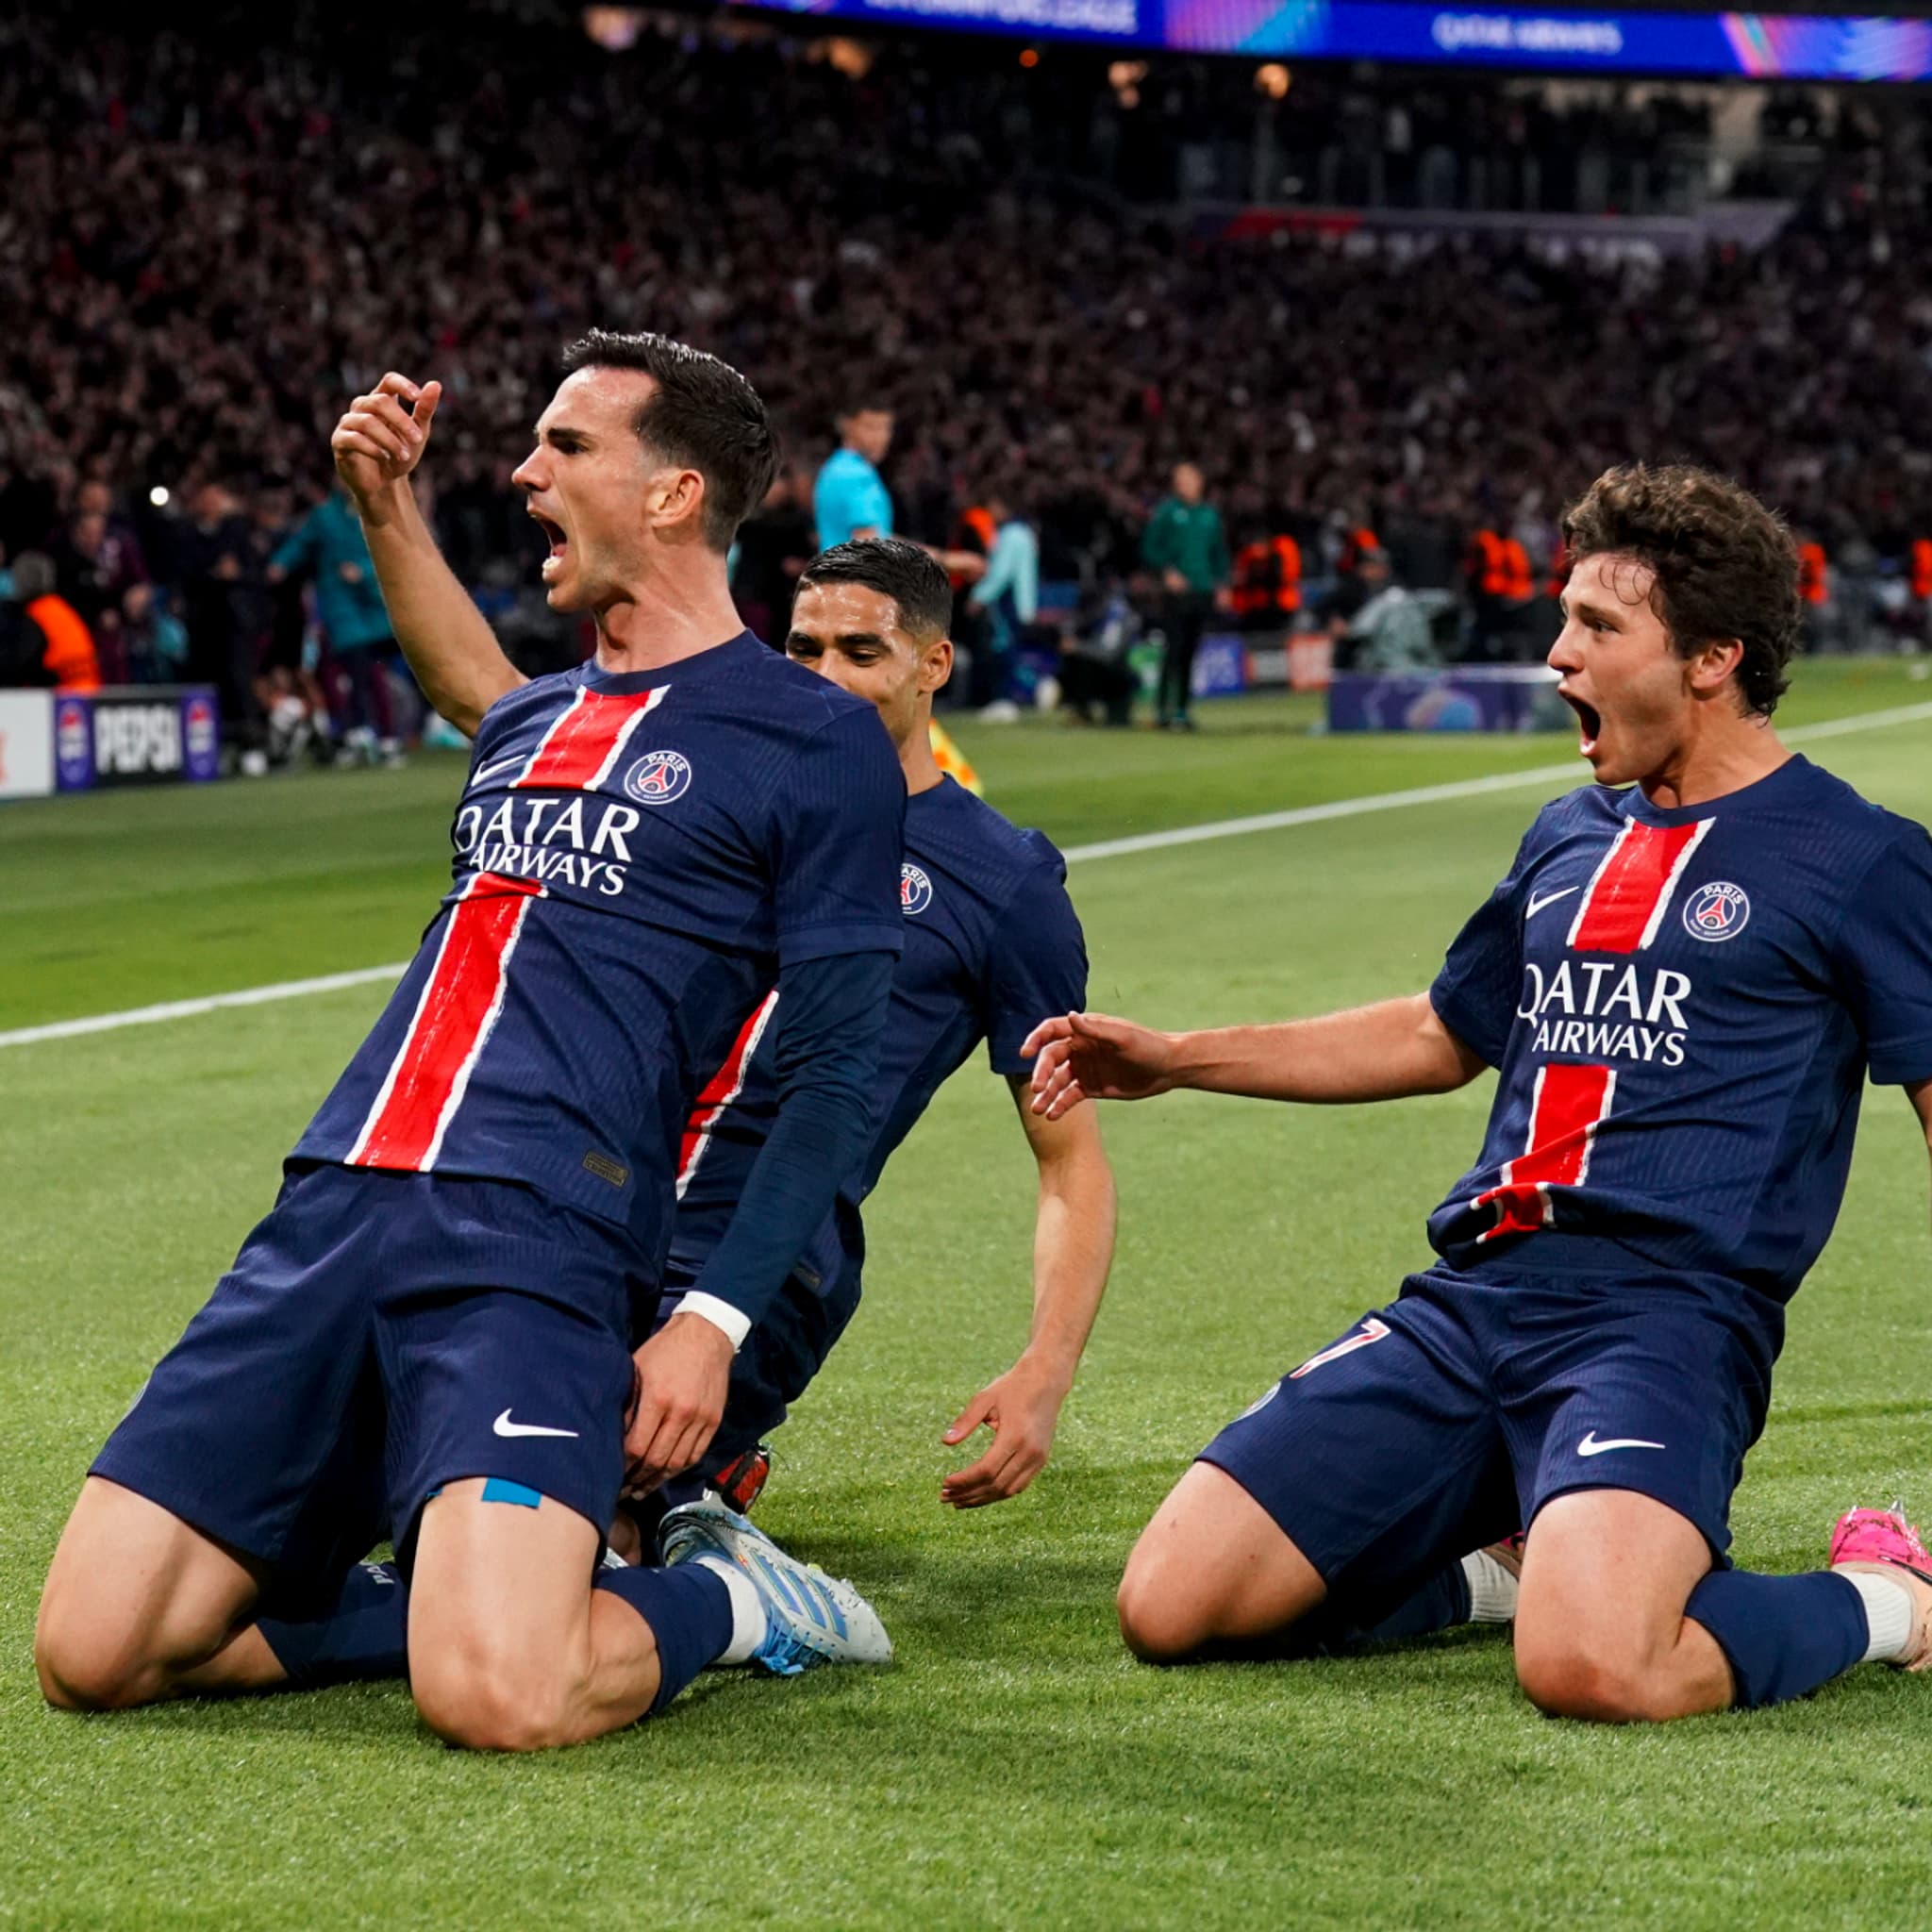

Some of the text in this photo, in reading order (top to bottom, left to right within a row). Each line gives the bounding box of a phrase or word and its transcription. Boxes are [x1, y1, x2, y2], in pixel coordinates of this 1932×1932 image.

[94, 705, 182, 774] PEPSI
[647, 753, 687, 772] PARIS
[454, 796, 641, 863] QATAR
[469, 842, 627, 895] AIRWAYS
[901, 866, 928, 889] ARIS
[1703, 884, 1744, 905] PARIS
[1516, 959, 1691, 1030] QATAR
[1531, 1019, 1686, 1066] AIRWAYS
